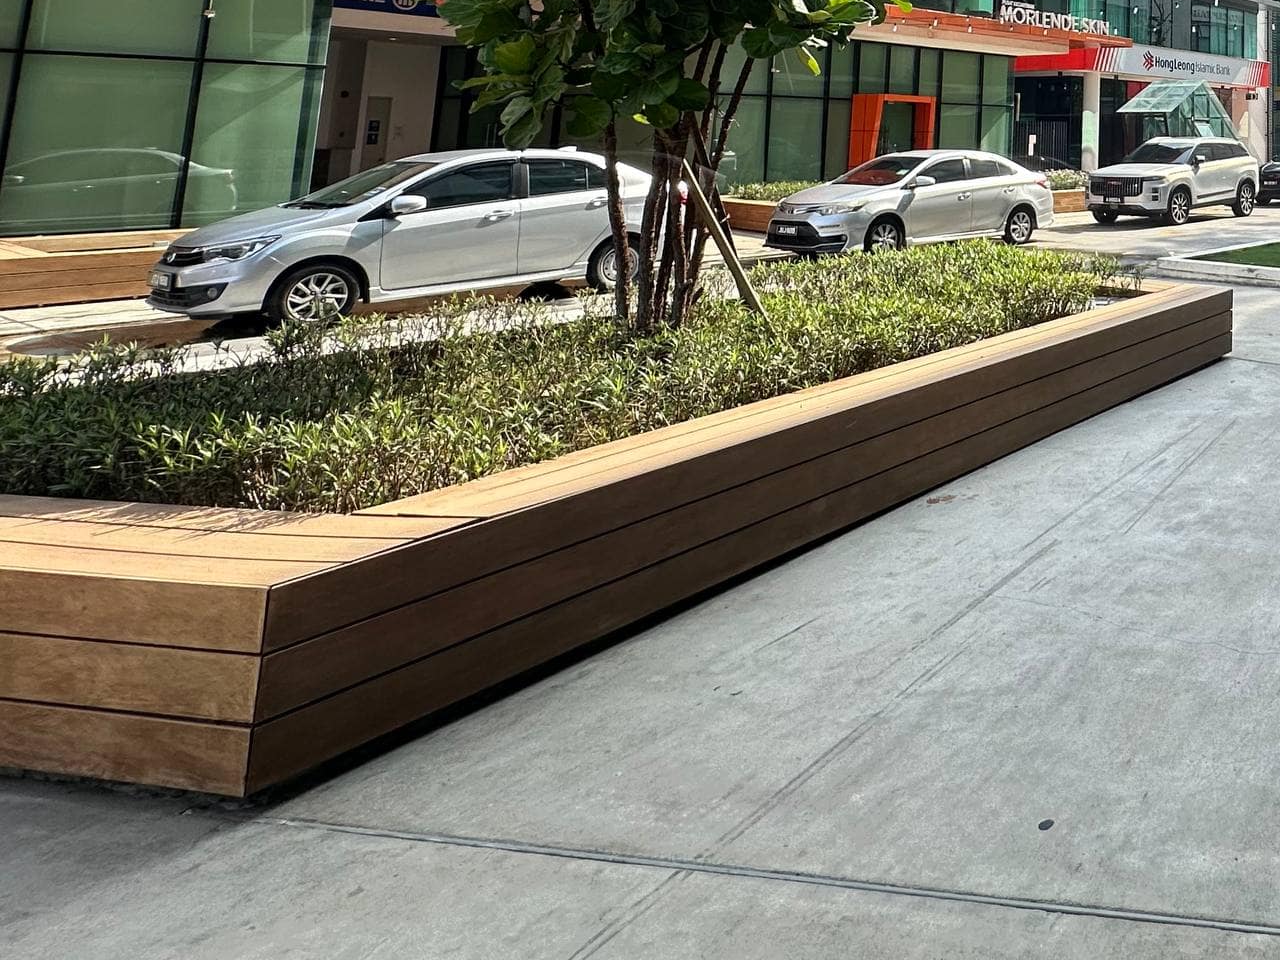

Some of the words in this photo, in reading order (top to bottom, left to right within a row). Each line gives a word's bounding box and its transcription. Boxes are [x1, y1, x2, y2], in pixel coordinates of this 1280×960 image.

[1000, 5, 1080, 33] MORLENDE
[1081, 17, 1110, 36] SKIN
[1155, 55, 1195, 75] HongLeong
[1195, 61, 1215, 74] Islamic
[1216, 63, 1231, 75] Bank
